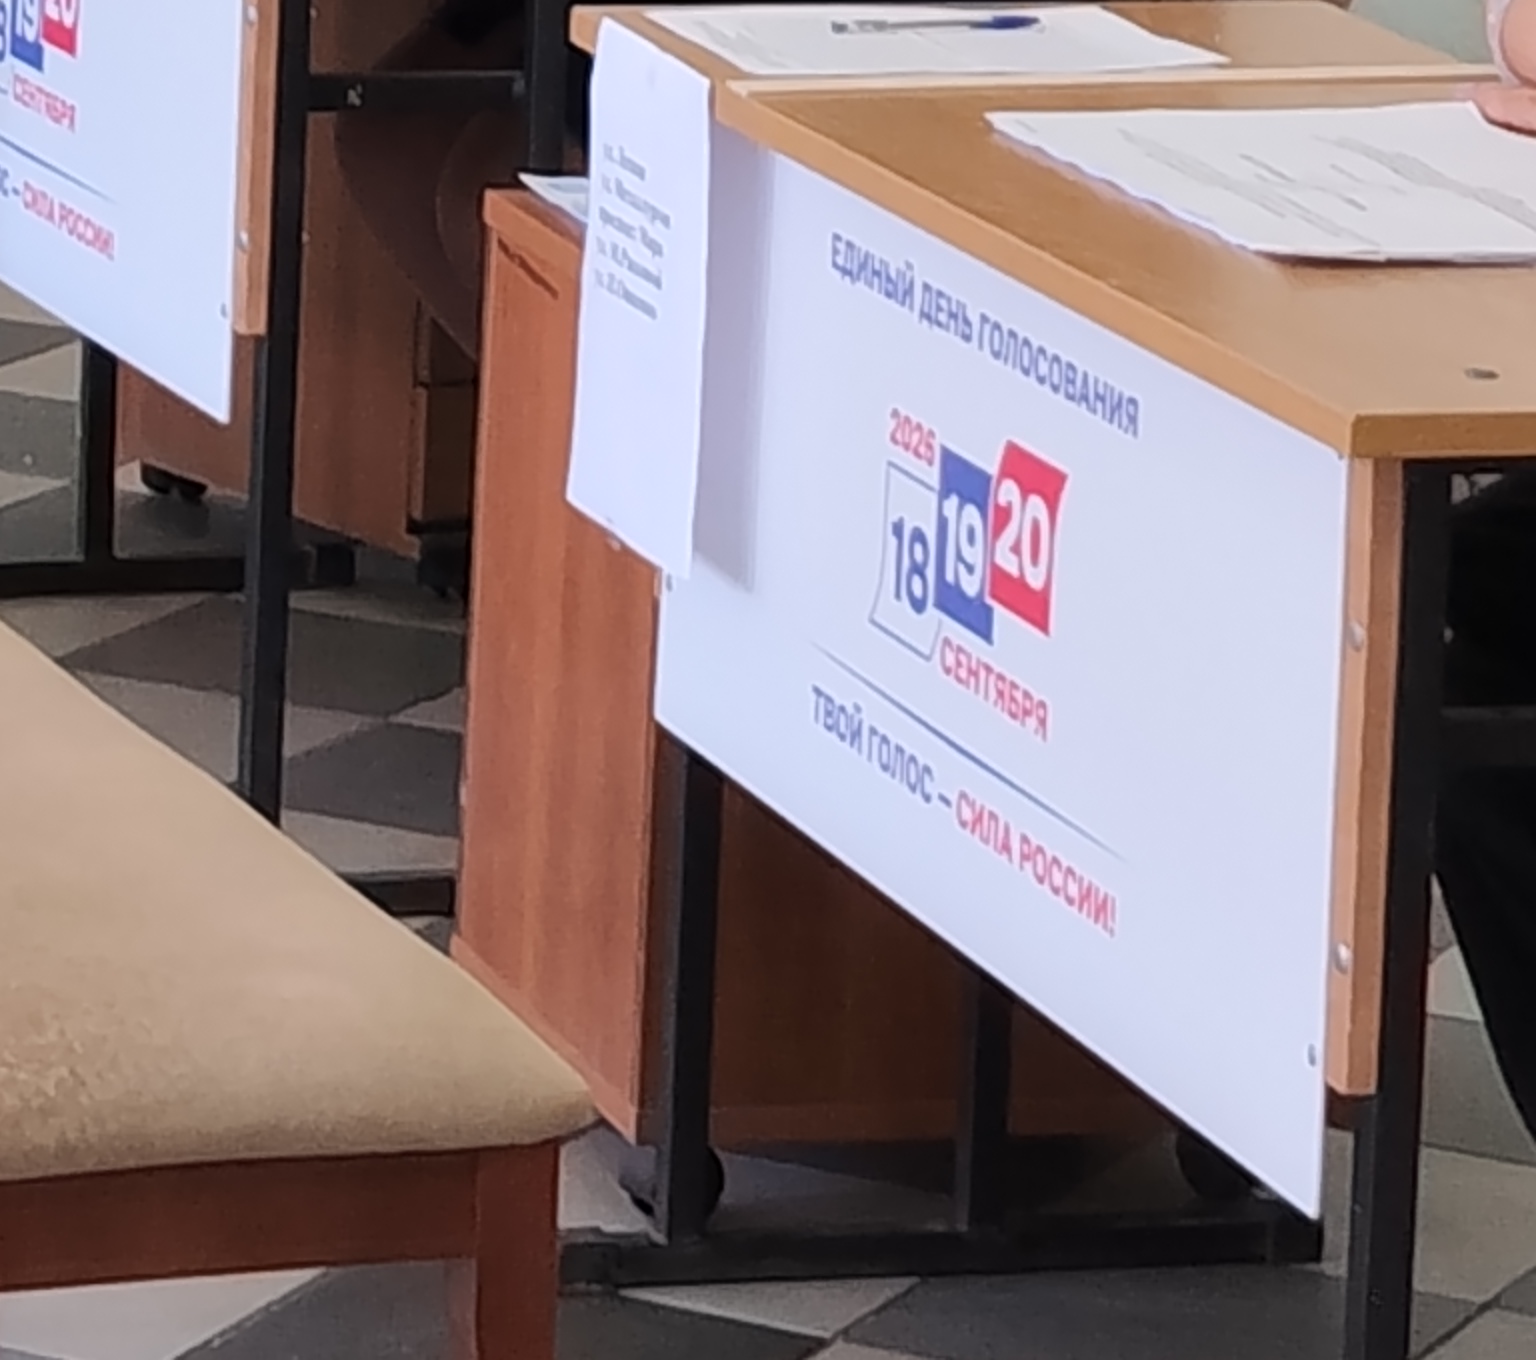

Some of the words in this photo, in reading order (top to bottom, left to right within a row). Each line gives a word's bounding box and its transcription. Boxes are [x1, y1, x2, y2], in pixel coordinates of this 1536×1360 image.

[13, 73, 76, 132] СЕНТЯБРЯ
[831, 231, 915, 314] ЕДИНЫЙ
[919, 281, 973, 344] ДЕНЬ
[977, 312, 1140, 439] ГОЛОСОВАНИЯ
[889, 407, 936, 467] 2026
[891, 516, 930, 615] 18
[942, 493, 984, 599] 19
[994, 478, 1050, 592] 20
[939, 635, 1049, 742] СЕНТЯБРЯ
[812, 684, 863, 756] ТВОЙ
[866, 725, 934, 805] ГОЛОС
[956, 789, 1014, 864] СИЛА
[1019, 832, 1117, 938] РОССИИ!
